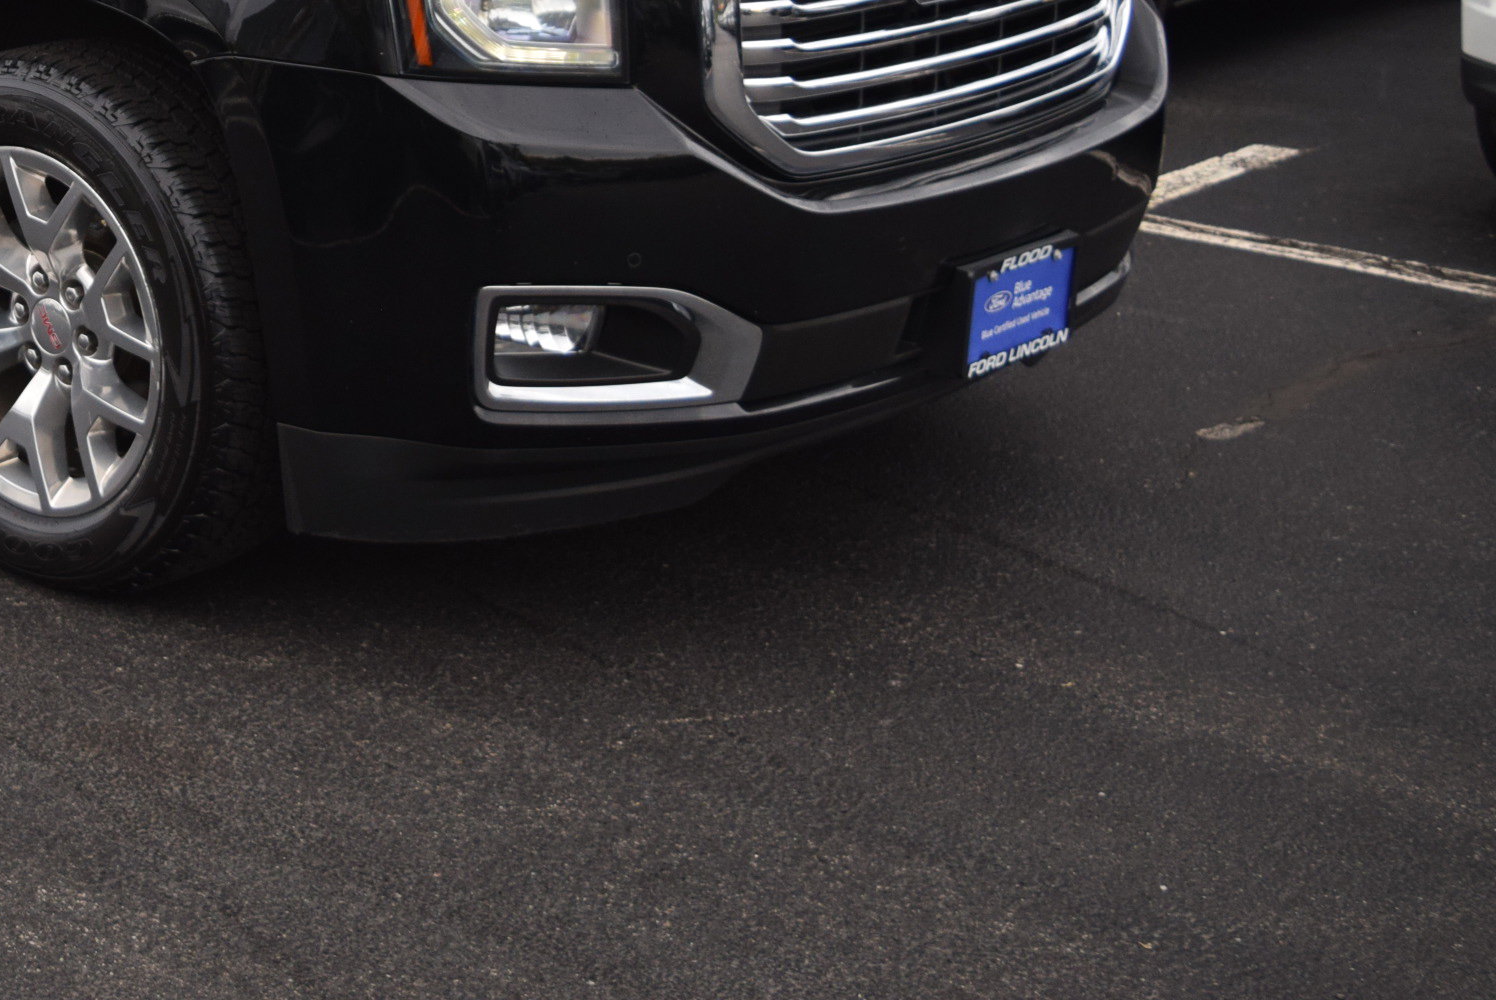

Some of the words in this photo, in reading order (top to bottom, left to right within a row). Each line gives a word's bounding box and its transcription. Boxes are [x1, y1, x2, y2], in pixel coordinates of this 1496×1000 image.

[1000, 245, 1052, 273] FLOOD
[1012, 286, 1054, 310] Advantage
[1014, 280, 1033, 295] Blue
[967, 351, 1007, 378] FORD
[1009, 329, 1068, 361] LINCOLN
